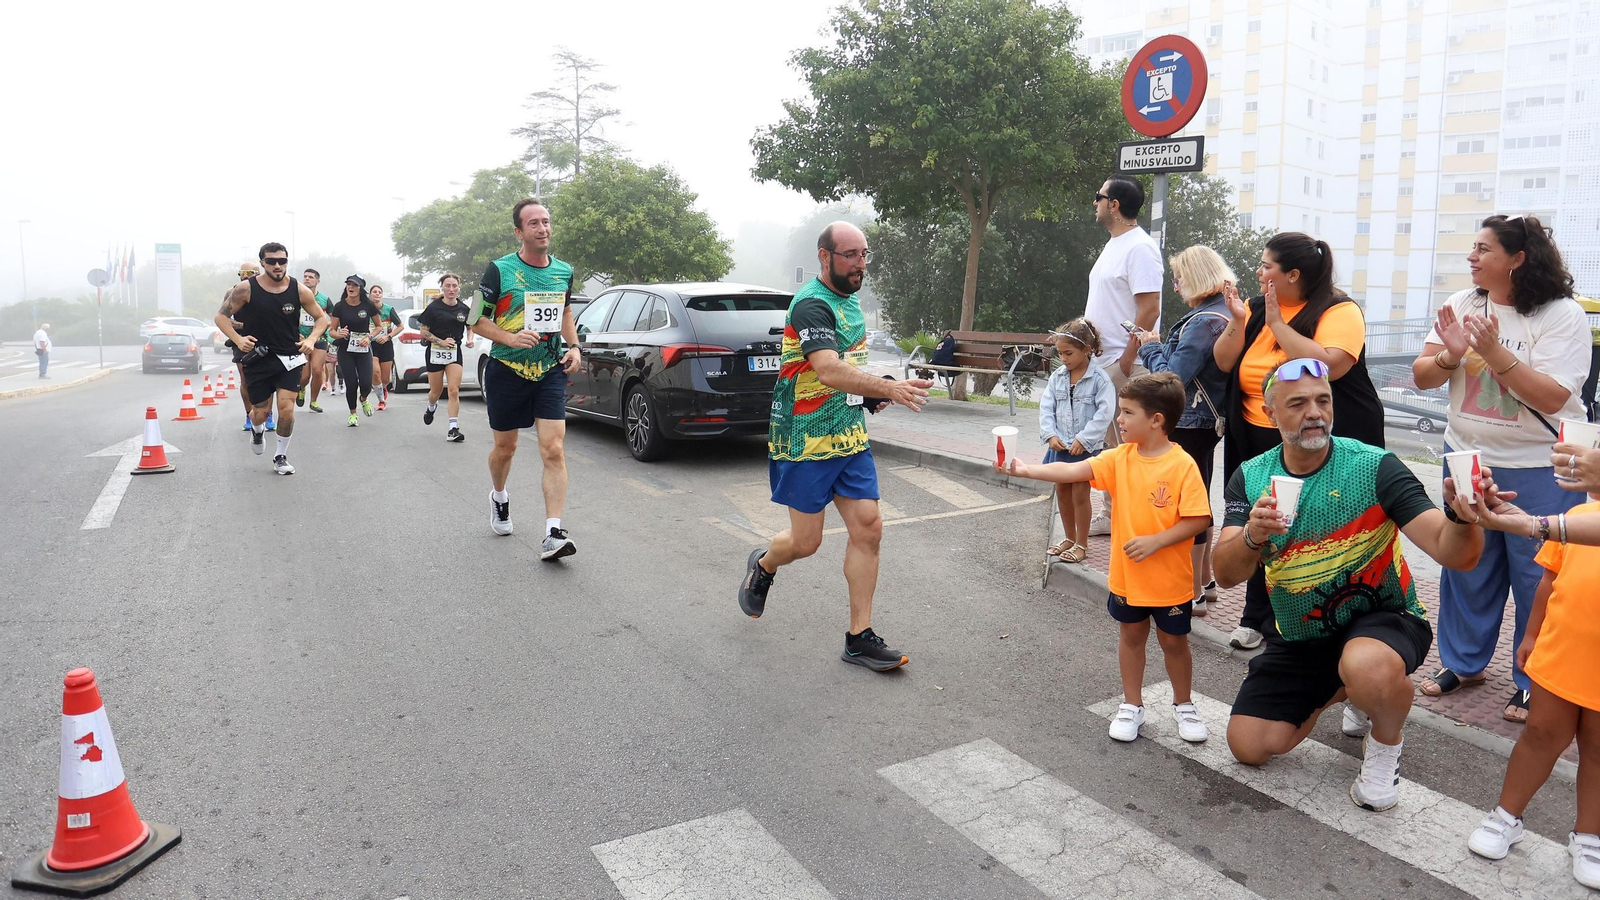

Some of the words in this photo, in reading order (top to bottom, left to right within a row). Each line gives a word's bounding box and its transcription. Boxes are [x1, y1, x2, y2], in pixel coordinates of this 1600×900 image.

[1146, 65, 1177, 77] EXCEPTO
[1135, 144, 1181, 156] EXCEPTO
[1123, 155, 1192, 168] MINUSVALIDO
[533, 307, 559, 322] 399
[435, 351, 453, 360] 353
[757, 358, 782, 369] 314
